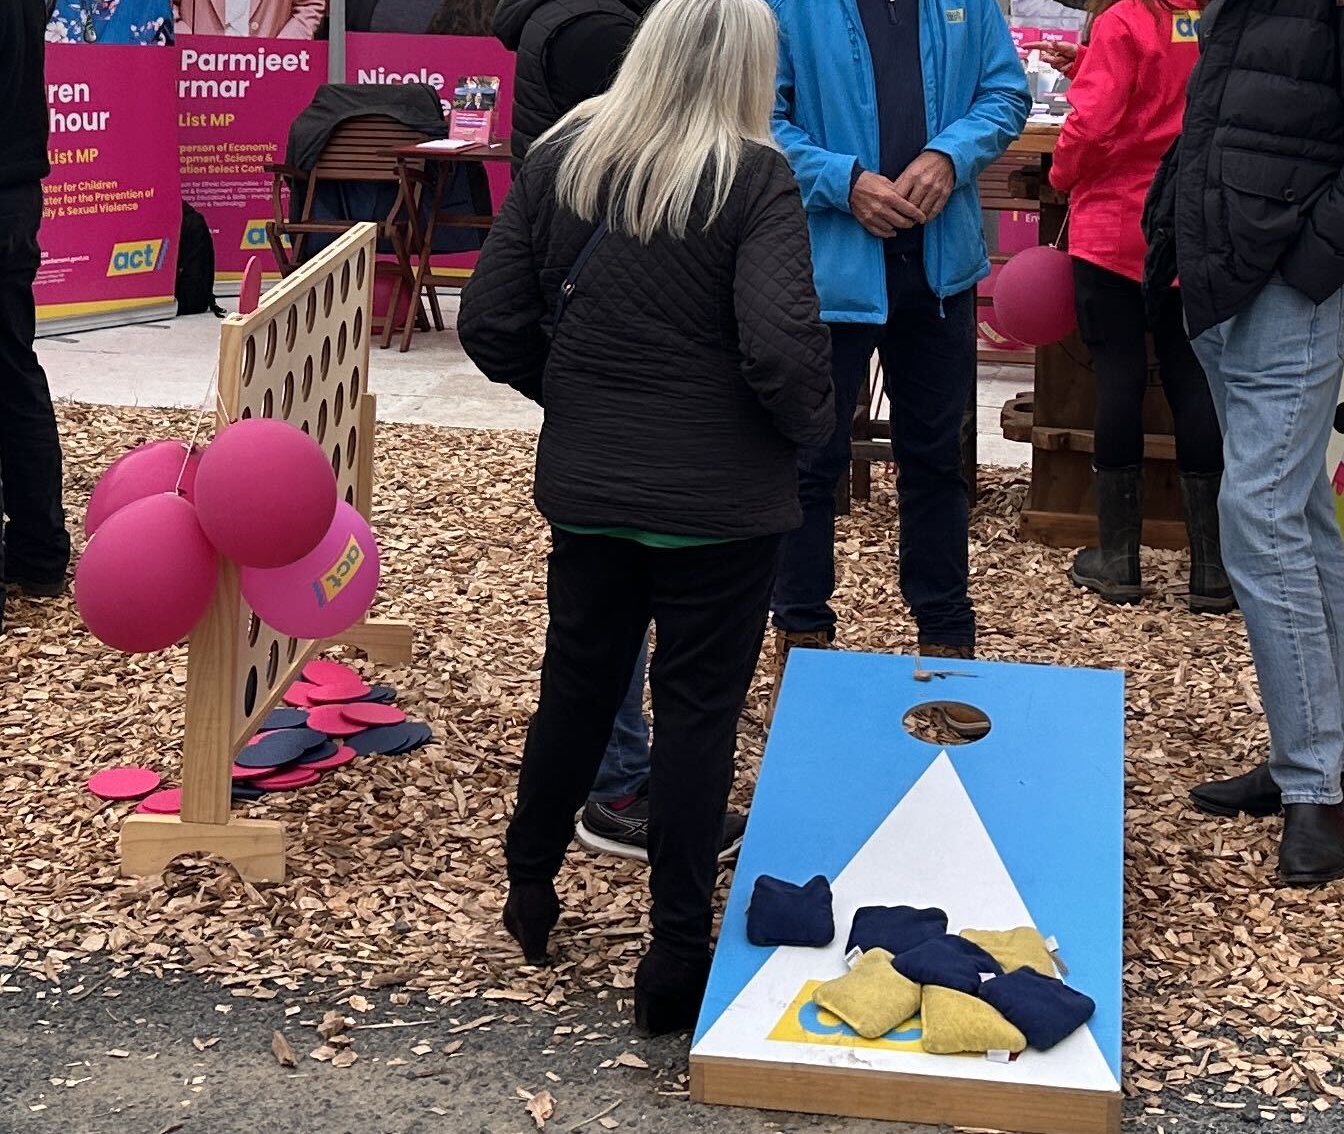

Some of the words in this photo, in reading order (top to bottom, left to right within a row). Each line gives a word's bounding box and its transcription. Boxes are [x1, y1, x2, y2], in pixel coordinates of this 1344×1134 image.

[181, 47, 310, 79] Parmjeet
[357, 66, 445, 91] Nicole
[178, 112, 207, 127] List
[210, 113, 235, 127] MP
[216, 142, 228, 152] of
[228, 142, 278, 151] Economic
[48, 149, 74, 165] List
[75, 147, 99, 164] MP
[224, 153, 264, 163] Science
[63, 181, 77, 193] for
[77, 179, 118, 192] Children
[63, 193, 77, 204] for
[78, 192, 94, 204] the
[94, 189, 144, 202] Prevention
[144, 187, 155, 198] of
[57, 207, 65, 217] &
[66, 204, 98, 216] Sexual
[98, 201, 139, 214] Violence
[113, 243, 154, 271] act
[326, 545, 360, 589] act
